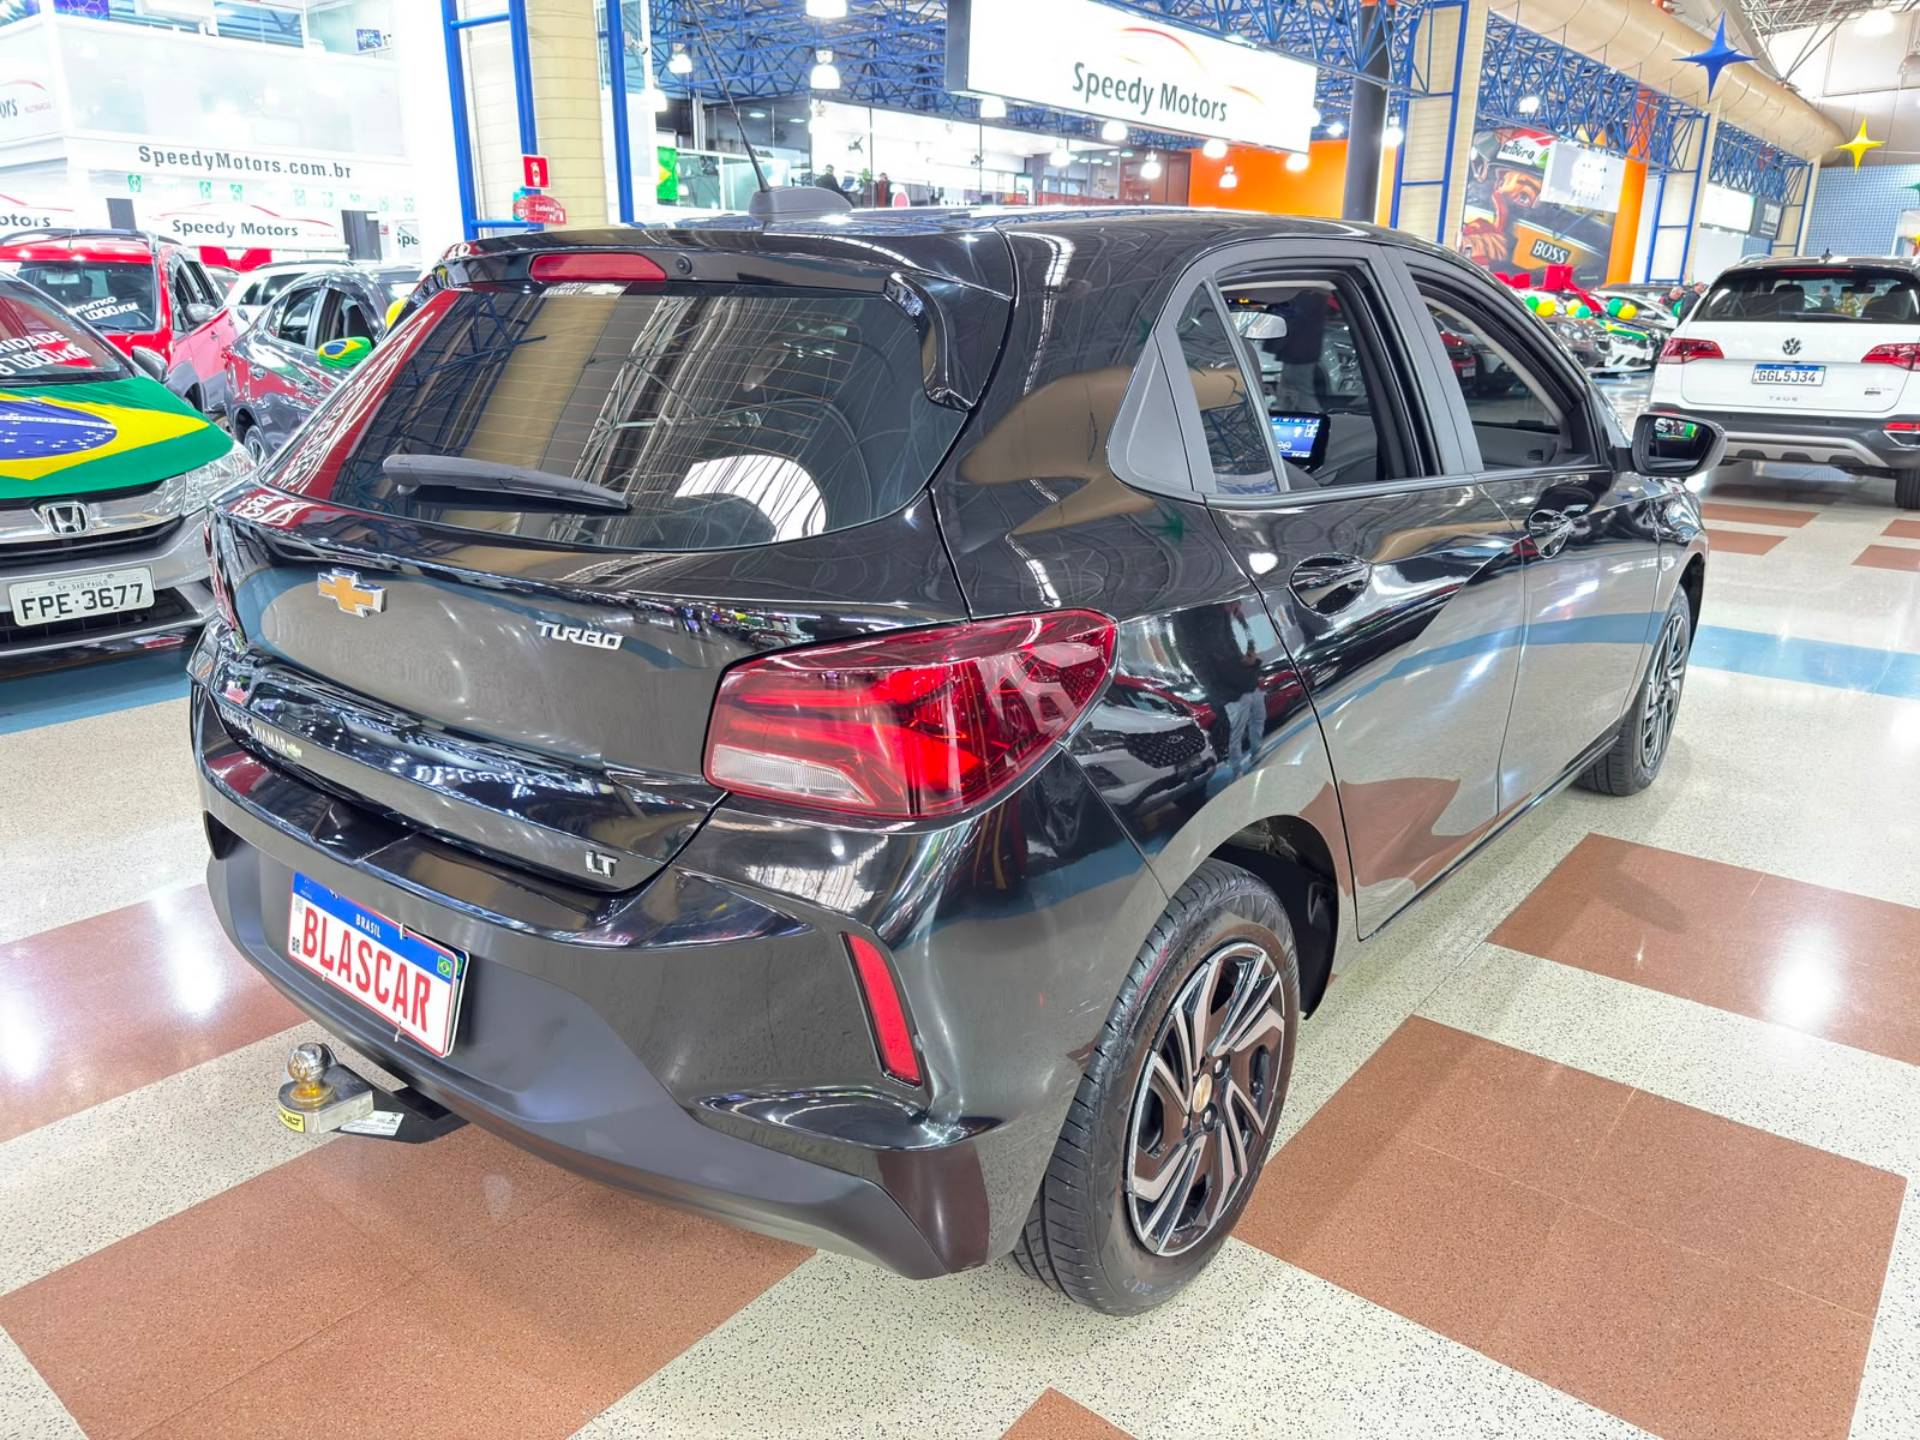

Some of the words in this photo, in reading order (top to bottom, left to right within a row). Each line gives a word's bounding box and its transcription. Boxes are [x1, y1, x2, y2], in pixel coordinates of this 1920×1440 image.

[1073, 62, 1154, 115] Speedy
[1159, 83, 1228, 122] Motors
[138, 145, 351, 178] SpeedyMotors.com.br
[172, 219, 235, 238] Speedy
[240, 222, 299, 236] Motors
[1532, 240, 1569, 264] BOSS
[536, 620, 624, 650] TURBO
[585, 850, 618, 878] LT
[355, 912, 382, 939] BRASIL
[302, 905, 432, 1033] BLASCAR
